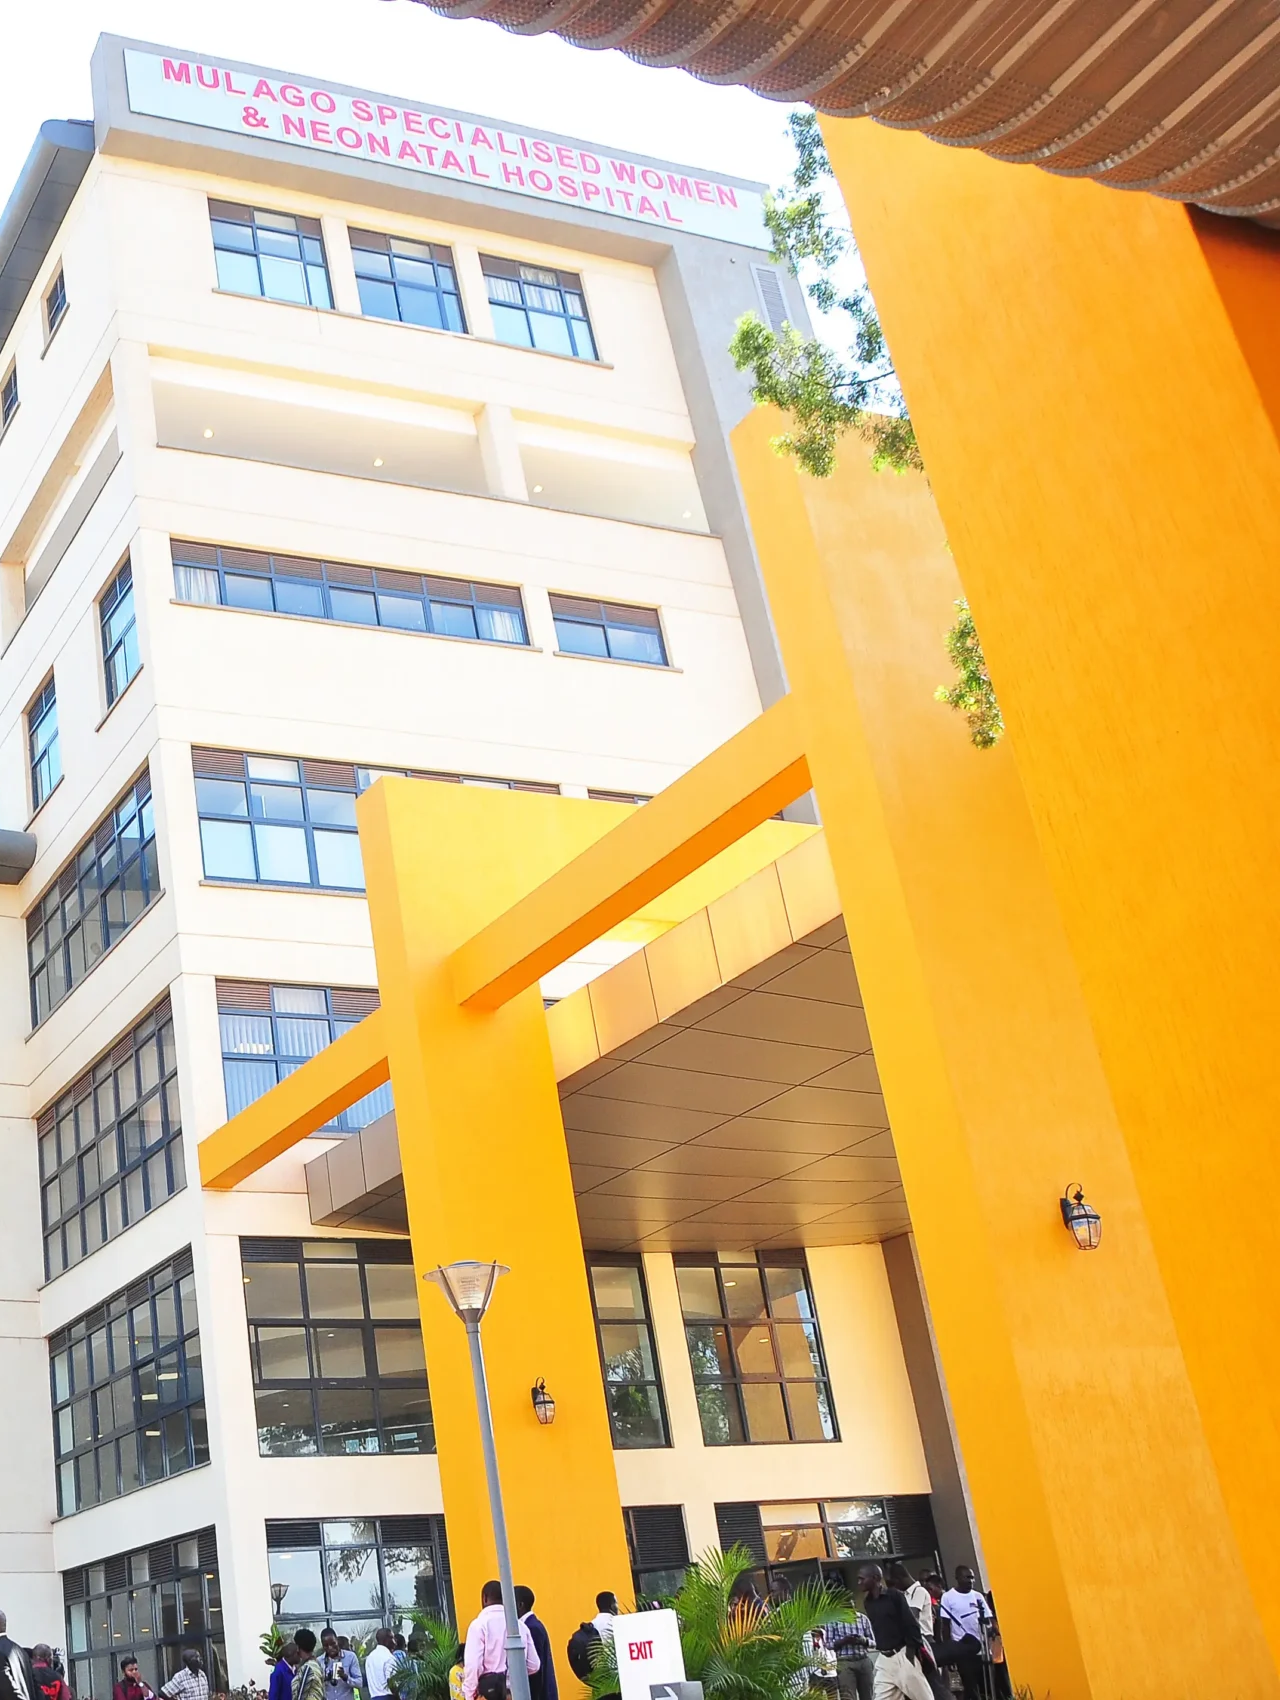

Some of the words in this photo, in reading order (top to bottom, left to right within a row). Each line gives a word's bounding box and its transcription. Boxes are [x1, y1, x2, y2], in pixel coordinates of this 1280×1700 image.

[162, 58, 337, 114] MULAGO
[350, 99, 602, 175] SPECIALISED
[609, 159, 739, 208] WOMEN
[241, 105, 270, 130] &
[281, 113, 490, 180] NEONATAL
[500, 161, 684, 223] HOSPITAL
[628, 1640, 654, 1661] EXIT
